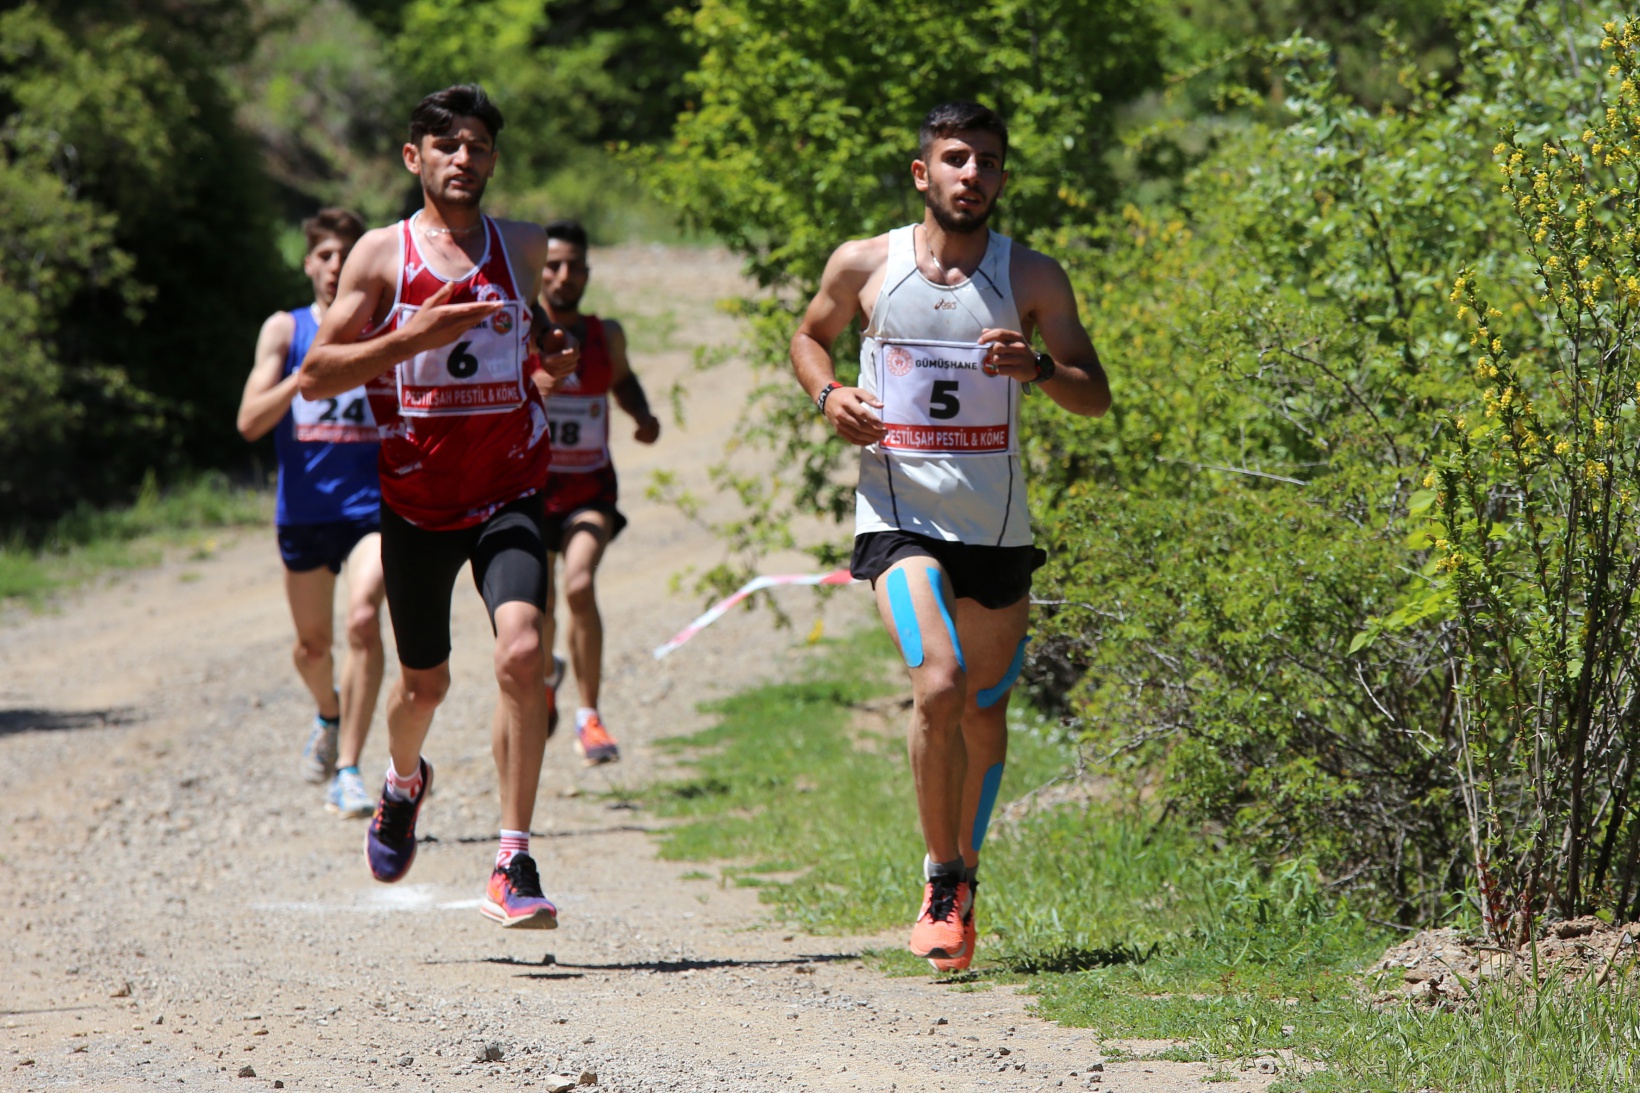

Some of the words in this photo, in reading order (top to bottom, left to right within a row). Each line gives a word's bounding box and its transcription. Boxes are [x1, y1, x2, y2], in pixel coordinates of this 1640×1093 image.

[447, 341, 479, 378] 6
[915, 357, 978, 370] GÜMÜŞHANE
[455, 386, 486, 405] PESTİL
[488, 388, 495, 402] &
[929, 380, 960, 420] 5
[318, 398, 365, 421] 24
[936, 428, 969, 447] PESTİL
[971, 433, 978, 447] &
[980, 428, 1005, 446] KÖME
